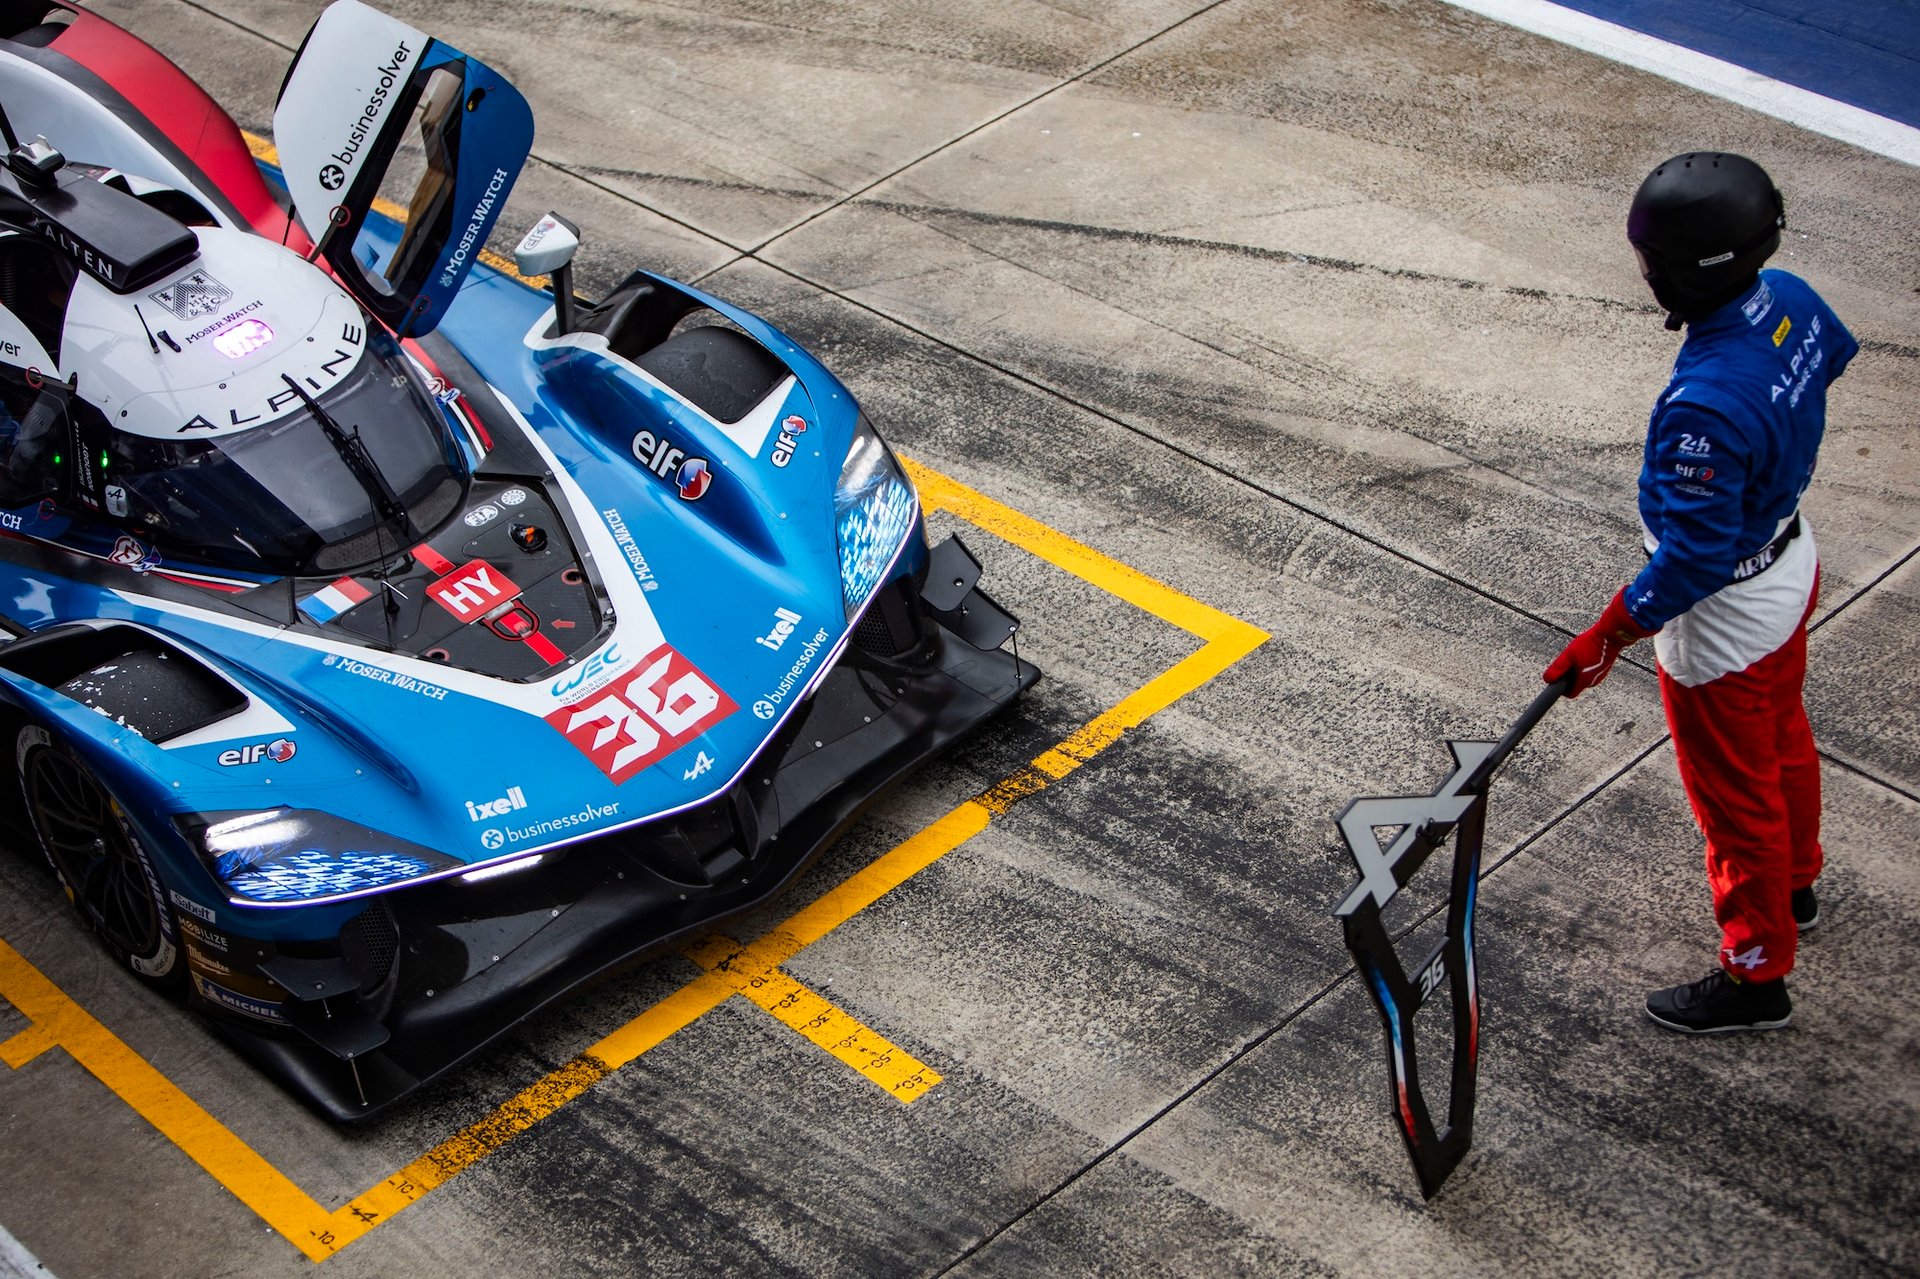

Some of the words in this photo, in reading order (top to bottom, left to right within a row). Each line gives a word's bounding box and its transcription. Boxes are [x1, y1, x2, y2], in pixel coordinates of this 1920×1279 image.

[332, 40, 411, 165] businessolver
[445, 168, 507, 276] MOSER.WATCH
[45, 224, 113, 280] ALTEN
[185, 300, 263, 344] MOSER.WATCH
[177, 323, 361, 432] ALPINE
[1771, 315, 1821, 403] ALPINE
[632, 430, 686, 478] elf
[771, 432, 794, 467] elf
[1675, 463, 1697, 477] elf
[604, 509, 651, 586] MOSER.WATCH
[439, 567, 501, 614] HY
[755, 607, 802, 650] ixell
[336, 657, 448, 701] MOSER.WATCH
[551, 642, 621, 697] WEC
[767, 627, 829, 704] businessolver
[566, 651, 719, 774] 36
[218, 744, 267, 766] elf
[464, 786, 527, 822] ixell
[505, 802, 620, 843] businessolver
[131, 837, 171, 935] MICHELIN
[174, 893, 210, 920] Sabelt
[1420, 949, 1445, 1003] 36
[223, 994, 281, 1018] MICHEL
[779, 993, 800, 1008] 20
[808, 1013, 830, 1028] 30
[870, 1054, 891, 1069] 50
[397, 1180, 414, 1194] 10
[318, 1230, 335, 1245] 10
